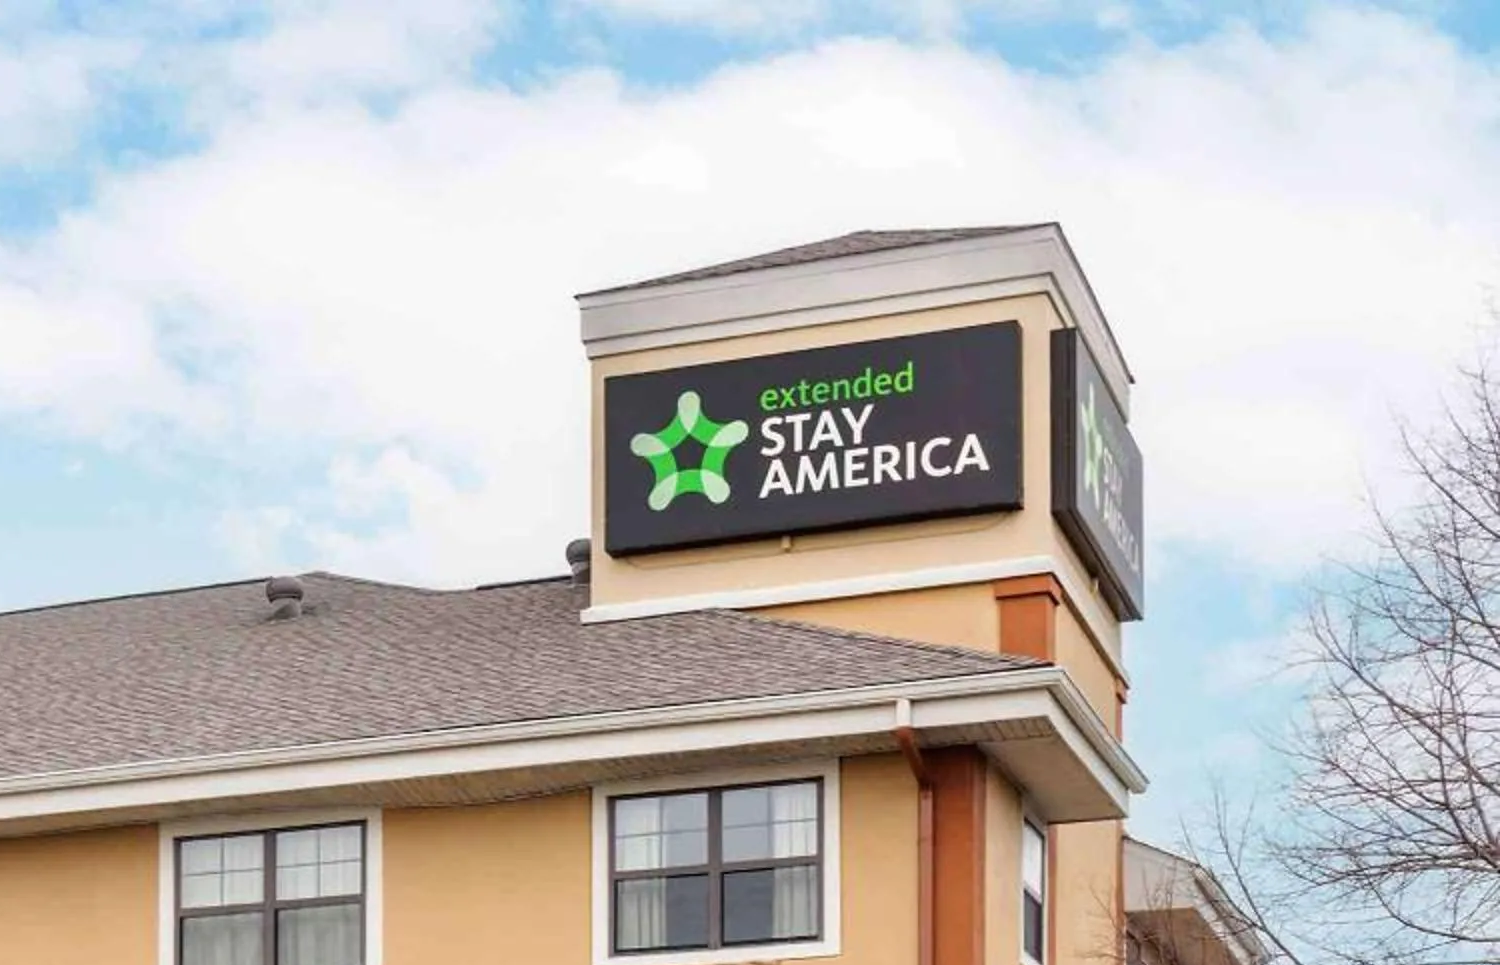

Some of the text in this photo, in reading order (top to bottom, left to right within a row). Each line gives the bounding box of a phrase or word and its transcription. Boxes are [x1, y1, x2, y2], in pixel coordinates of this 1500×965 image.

[760, 360, 914, 411] extended
[760, 403, 874, 457] STAY
[759, 433, 990, 499] AMERICA
